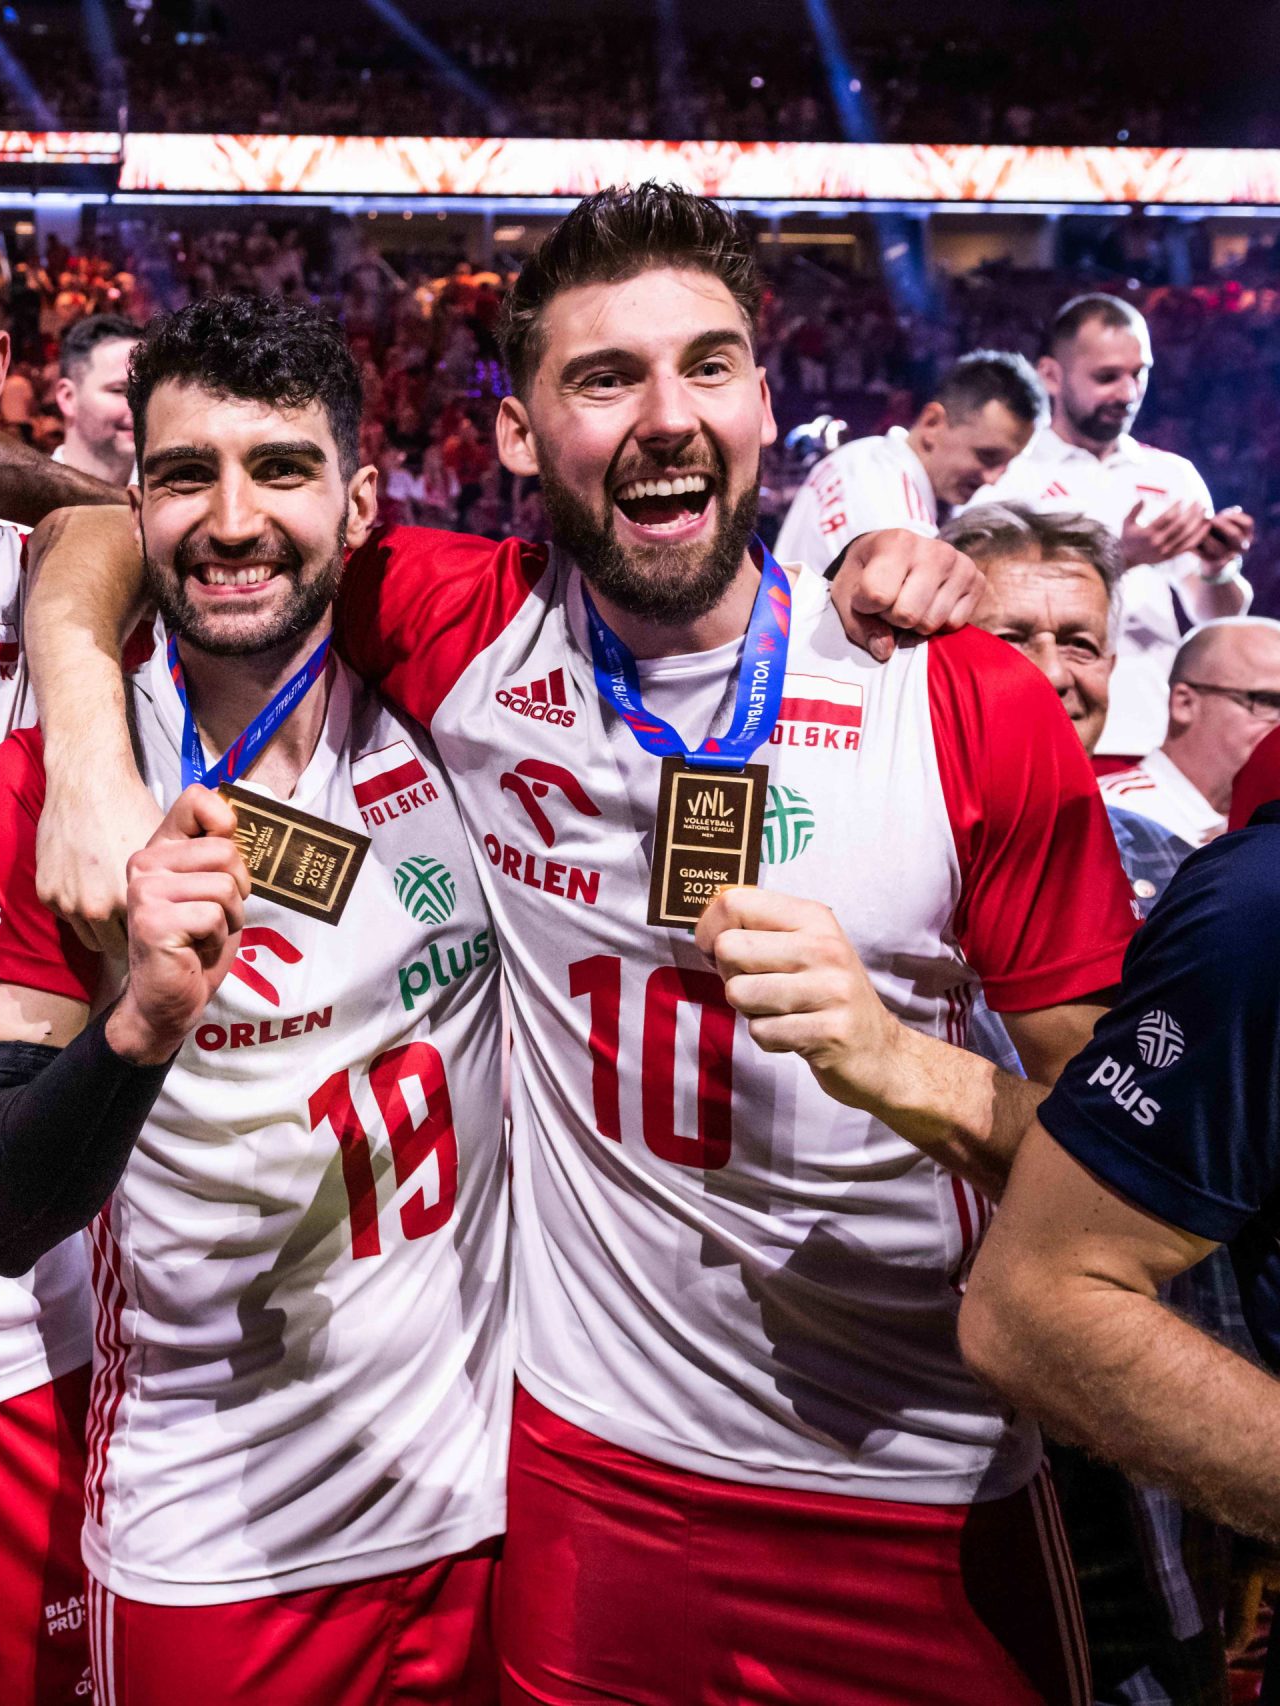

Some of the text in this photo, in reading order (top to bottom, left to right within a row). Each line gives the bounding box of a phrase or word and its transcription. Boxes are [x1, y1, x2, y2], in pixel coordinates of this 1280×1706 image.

[495, 688, 576, 728] adidas
[742, 660, 770, 732] VOLLEYBALL
[769, 725, 859, 751] OLSKA
[360, 781, 439, 830] POLSKA
[684, 817, 735, 828] VOLLEYBALL
[688, 788, 734, 817] VNL
[247, 826, 270, 868] VOLLEYBALL
[253, 827, 274, 871] NATIONS LEAGUE
[293, 843, 317, 886] GDAŃSK
[306, 853, 327, 887] 2023
[318, 857, 337, 890] WINNER
[484, 833, 600, 904] ORLEN
[679, 867, 728, 881] GDAŃSK
[683, 881, 720, 895] 2023
[683, 895, 715, 904] WINNE
[398, 927, 490, 1011] plus
[195, 1006, 333, 1052] ORLEN
[567, 954, 736, 1170] 10
[1087, 1055, 1162, 1126] plus
[308, 1041, 459, 1260] 19
